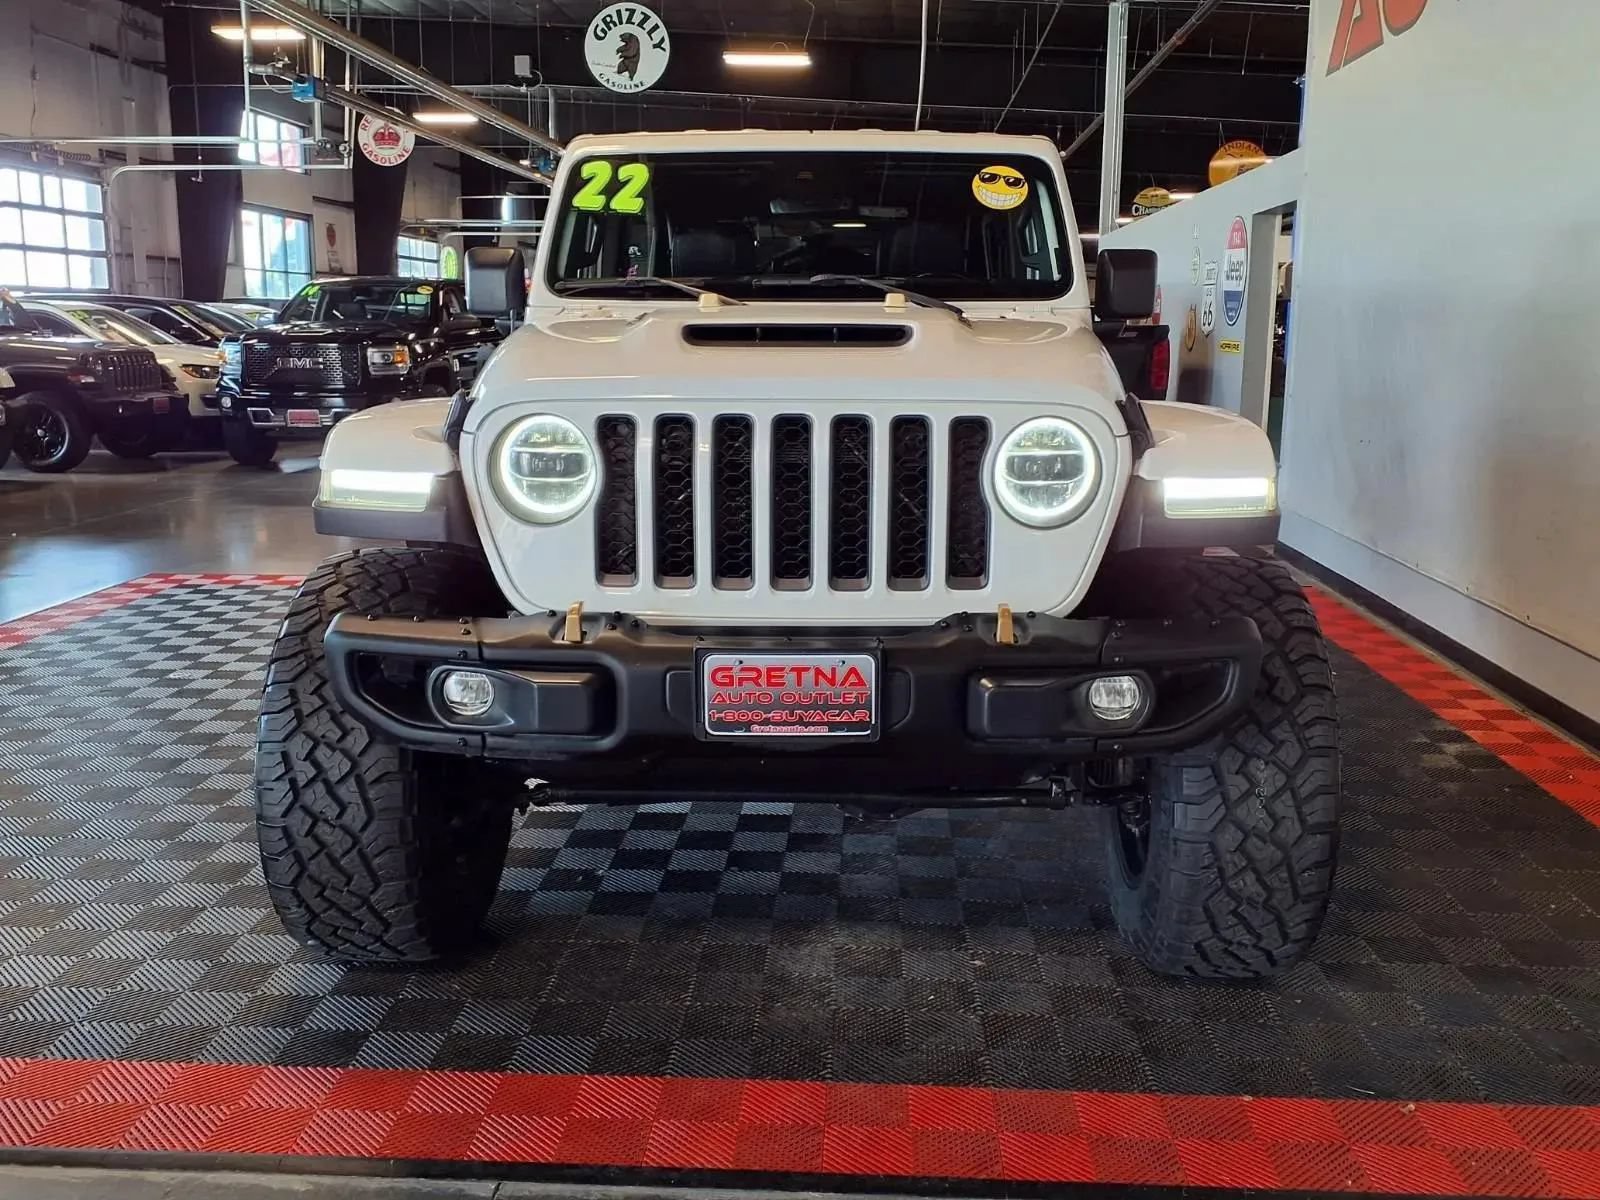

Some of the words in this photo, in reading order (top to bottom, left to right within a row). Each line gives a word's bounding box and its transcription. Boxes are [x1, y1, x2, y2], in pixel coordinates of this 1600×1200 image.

[593, 8, 666, 52] GRIZZLY
[599, 73, 645, 90] GASOLINE
[362, 143, 410, 165] GASOLINE
[572, 161, 649, 213] 22
[1225, 255, 1244, 287] Jeep
[1202, 301, 1213, 327] 66
[710, 666, 868, 688] GRETNA
[710, 691, 774, 704] AUTO
[779, 691, 870, 704] OUTLET
[709, 710, 869, 721] 1-800-BUYACAR
